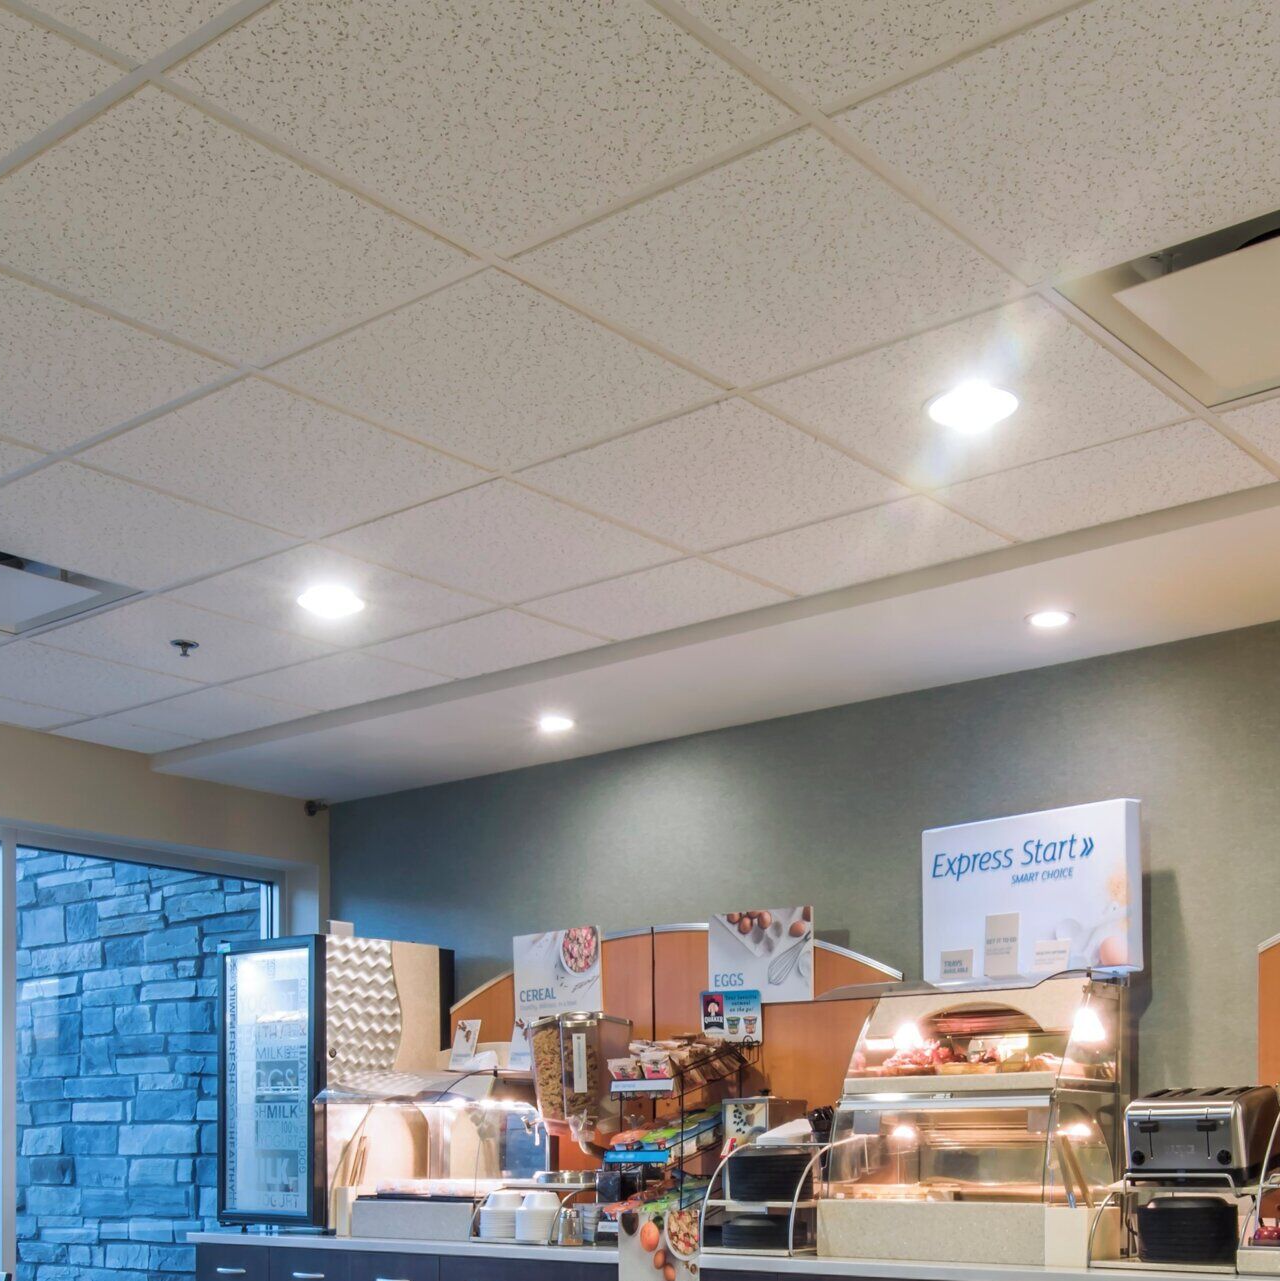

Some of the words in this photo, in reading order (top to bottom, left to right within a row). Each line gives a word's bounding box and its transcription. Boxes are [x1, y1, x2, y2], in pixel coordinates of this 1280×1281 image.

[932, 848, 1014, 881] Express
[1021, 834, 1077, 866] Start
[1011, 872, 1039, 884] SMART
[1041, 867, 1074, 881] CHOICE
[714, 973, 744, 988] EGGS
[520, 987, 557, 1003] CEREAL
[704, 1015, 724, 1024] QUAKER
